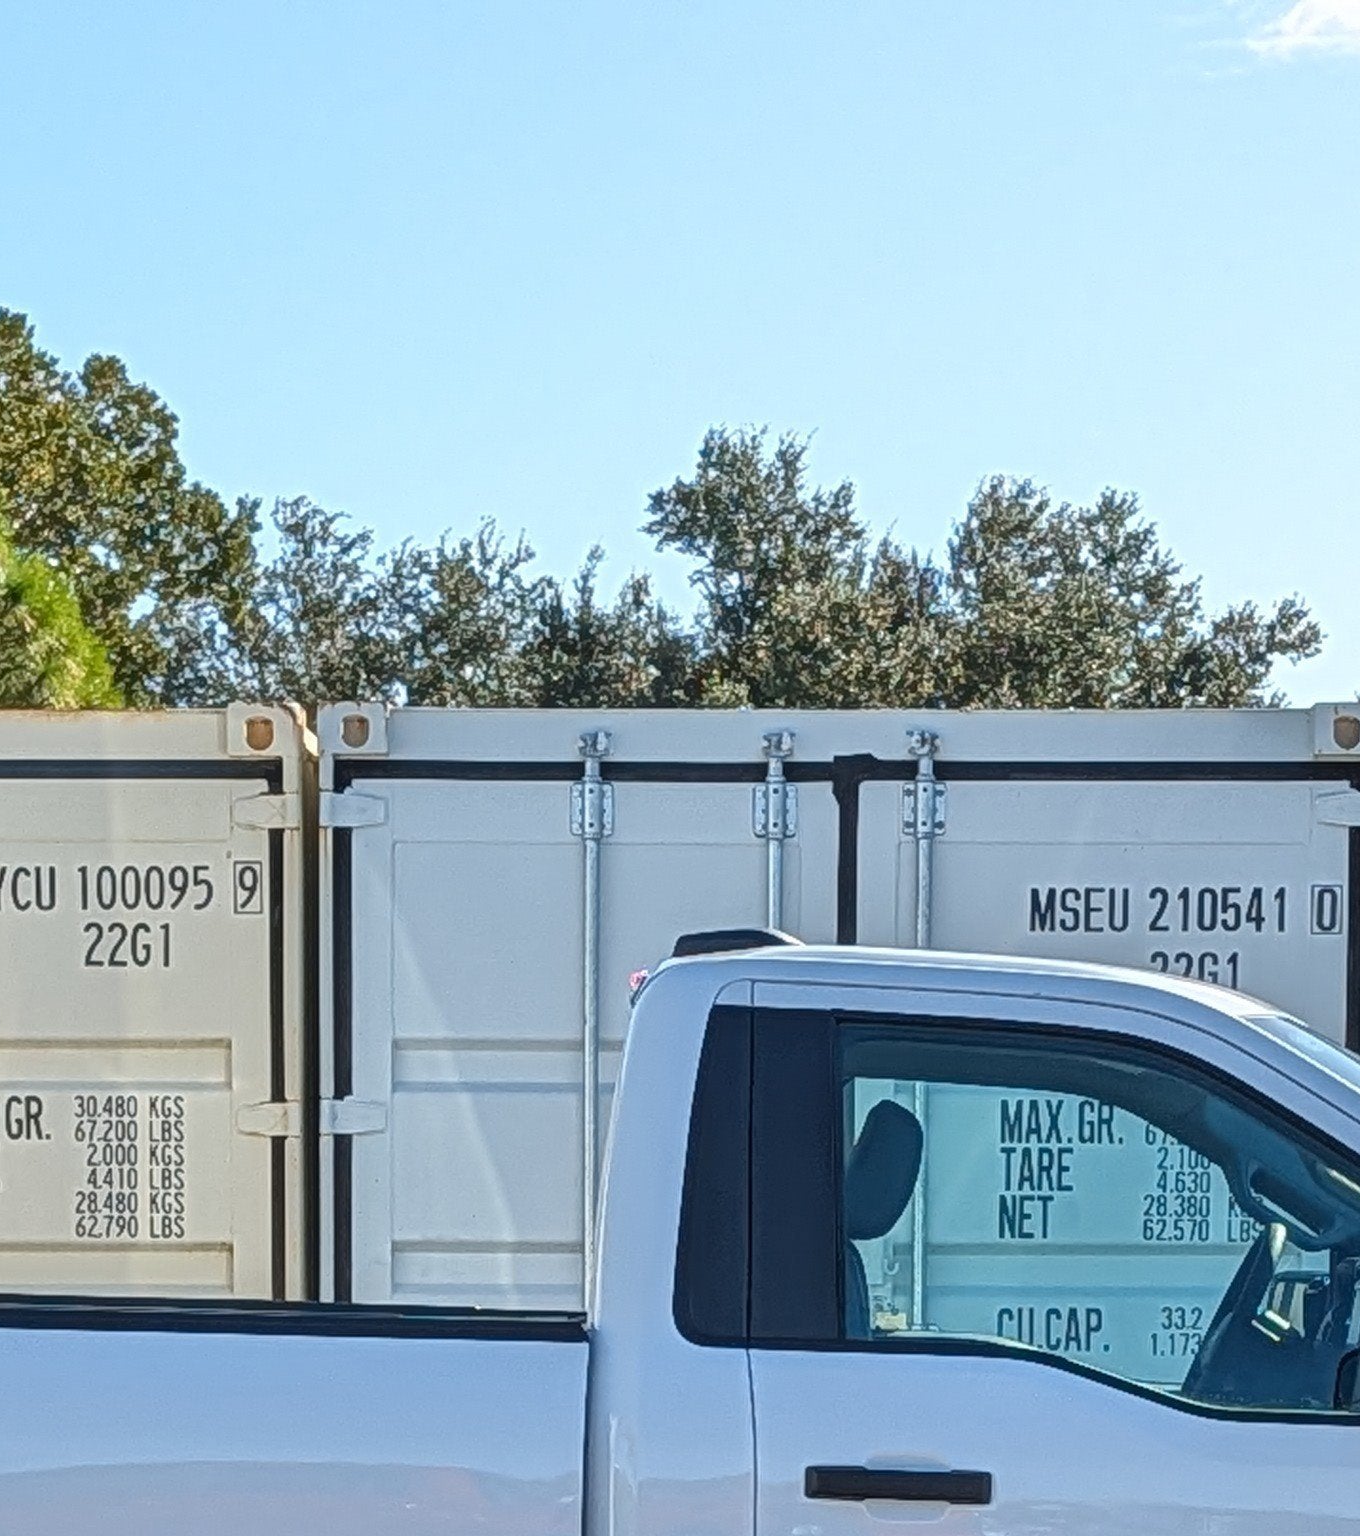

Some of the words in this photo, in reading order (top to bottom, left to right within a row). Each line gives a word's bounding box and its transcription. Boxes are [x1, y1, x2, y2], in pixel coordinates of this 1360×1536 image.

[77, 865, 214, 911] 100095
[238, 865, 259, 909] 9
[1029, 887, 1130, 933] MSEU
[1148, 886, 1286, 933] 210541
[83, 922, 170, 968] 22G1
[5, 1095, 51, 1140] GR.
[74, 1096, 139, 1119] 30.480
[148, 1096, 186, 1119] KGS
[74, 1120, 139, 1143] 67.200
[148, 1120, 186, 1143] LBS
[85, 1144, 139, 1167] 2.000
[148, 1144, 186, 1167] KGS
[85, 1168, 139, 1191] 4.410
[148, 1168, 186, 1191] LBS
[1000, 1146, 1074, 1192] TARE
[1156, 1171, 1211, 1194] 4.630
[74, 1192, 139, 1215] 28.480
[148, 1192, 186, 1215] KGS
[1143, 1194, 1211, 1218] 28.380
[74, 1216, 139, 1239] 62.790
[148, 1216, 186, 1239] LBS
[998, 1194, 1055, 1239] NET
[1142, 1218, 1210, 1241] 62.570
[1161, 1306, 1203, 1330] 33.2
[1151, 1333, 1202, 1356] 1.173
